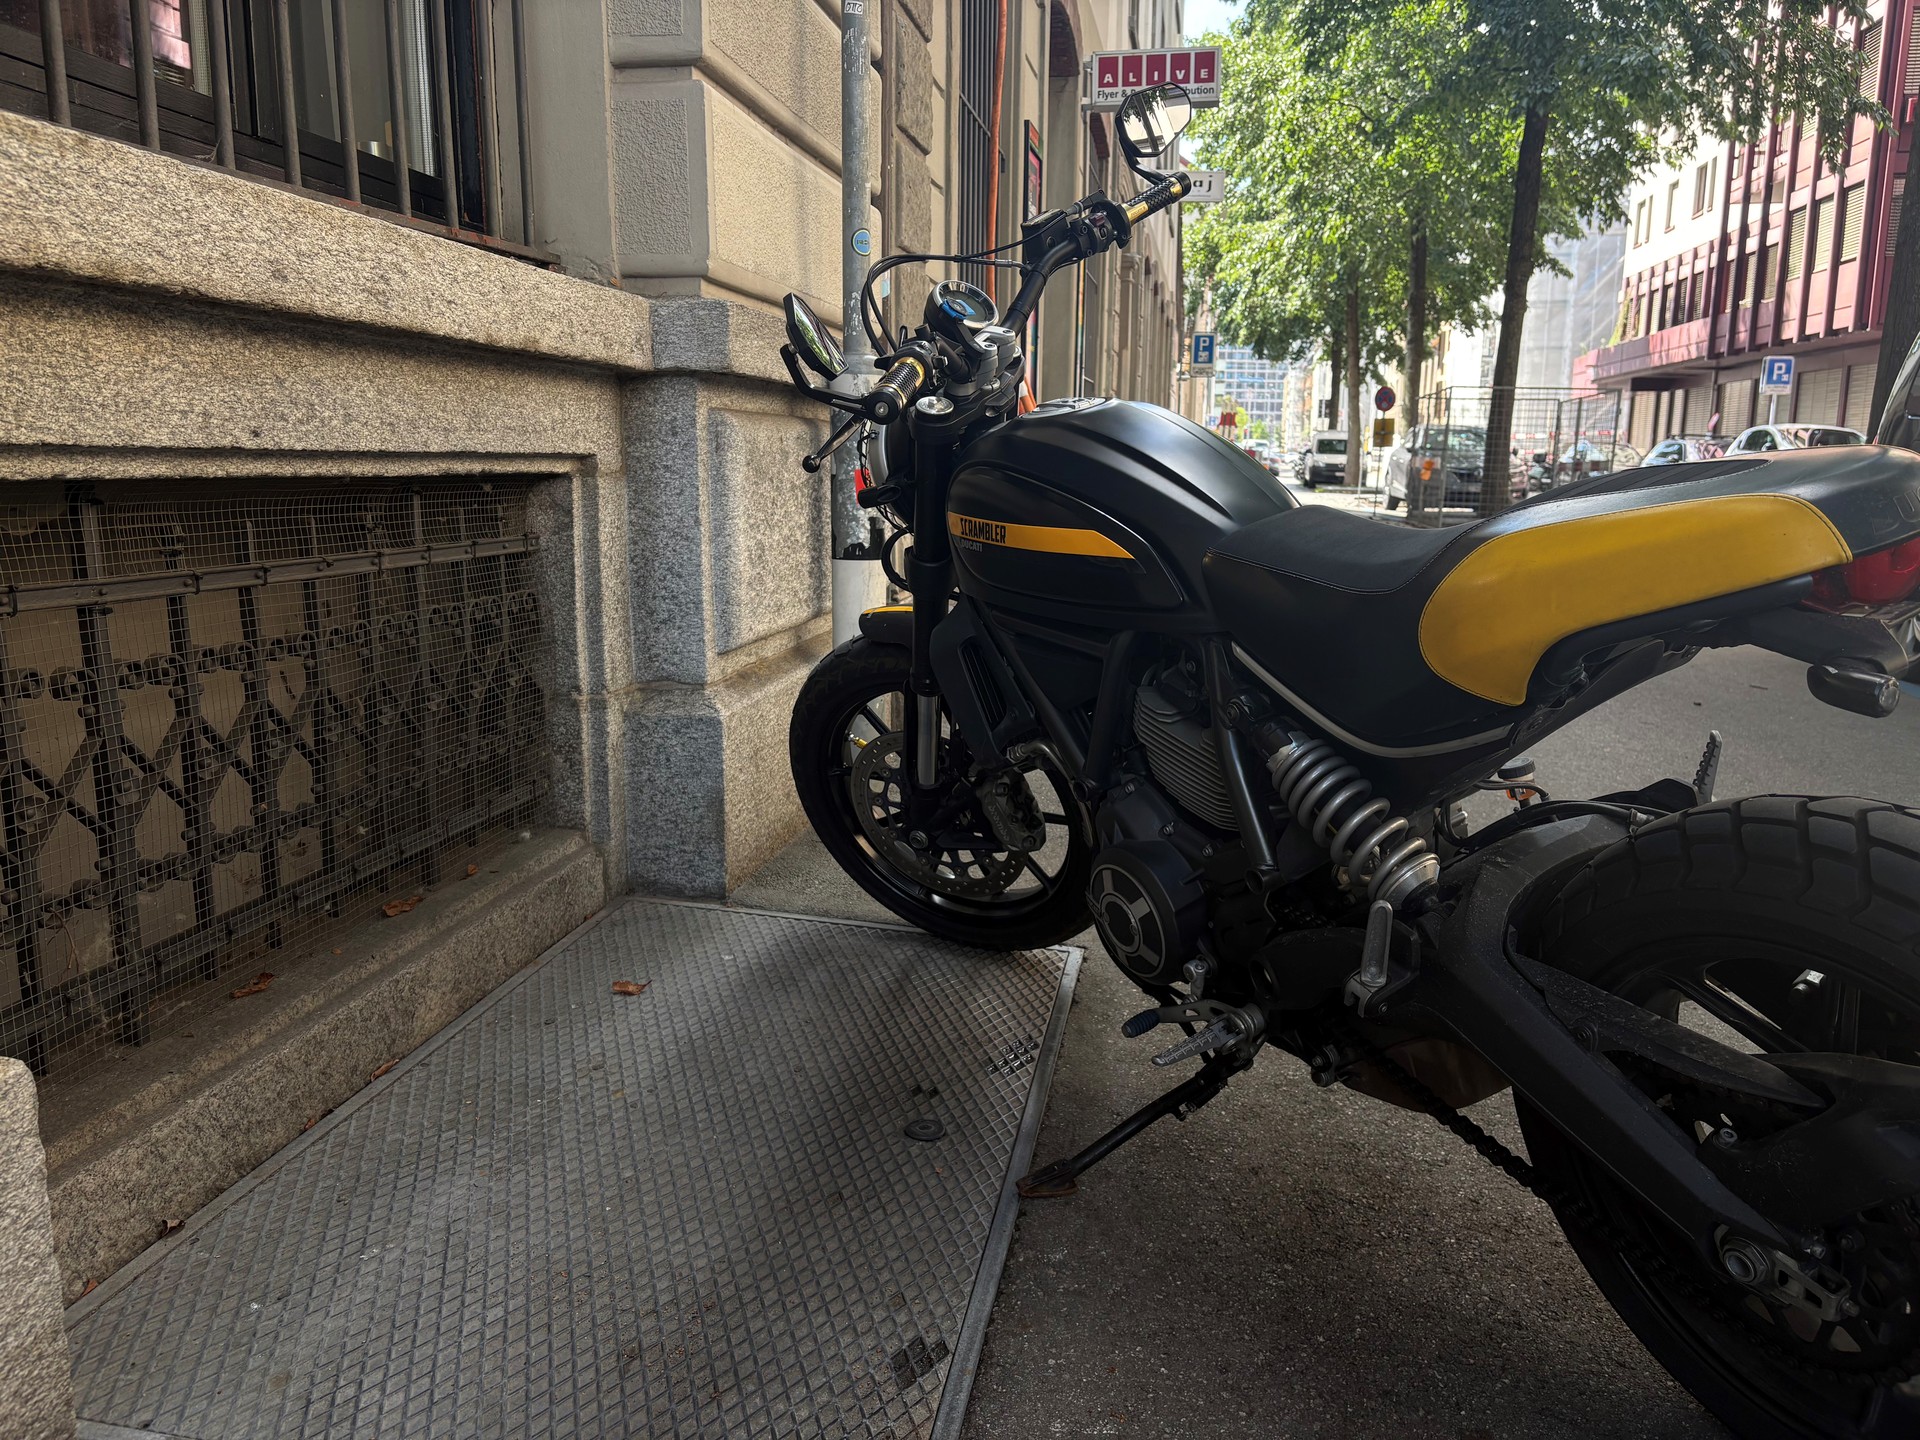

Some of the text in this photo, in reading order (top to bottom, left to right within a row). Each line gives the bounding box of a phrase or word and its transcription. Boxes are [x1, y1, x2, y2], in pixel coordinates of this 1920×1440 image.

[1103, 69, 1208, 83] ALIVE
[1097, 90, 1119, 101] Flyer
[1183, 85, 1215, 95] bution
[1199, 337, 1210, 351] P
[1772, 362, 1787, 381] P
[960, 517, 1006, 544] SCRAMBLER
[960, 539, 983, 552] DUCATI
